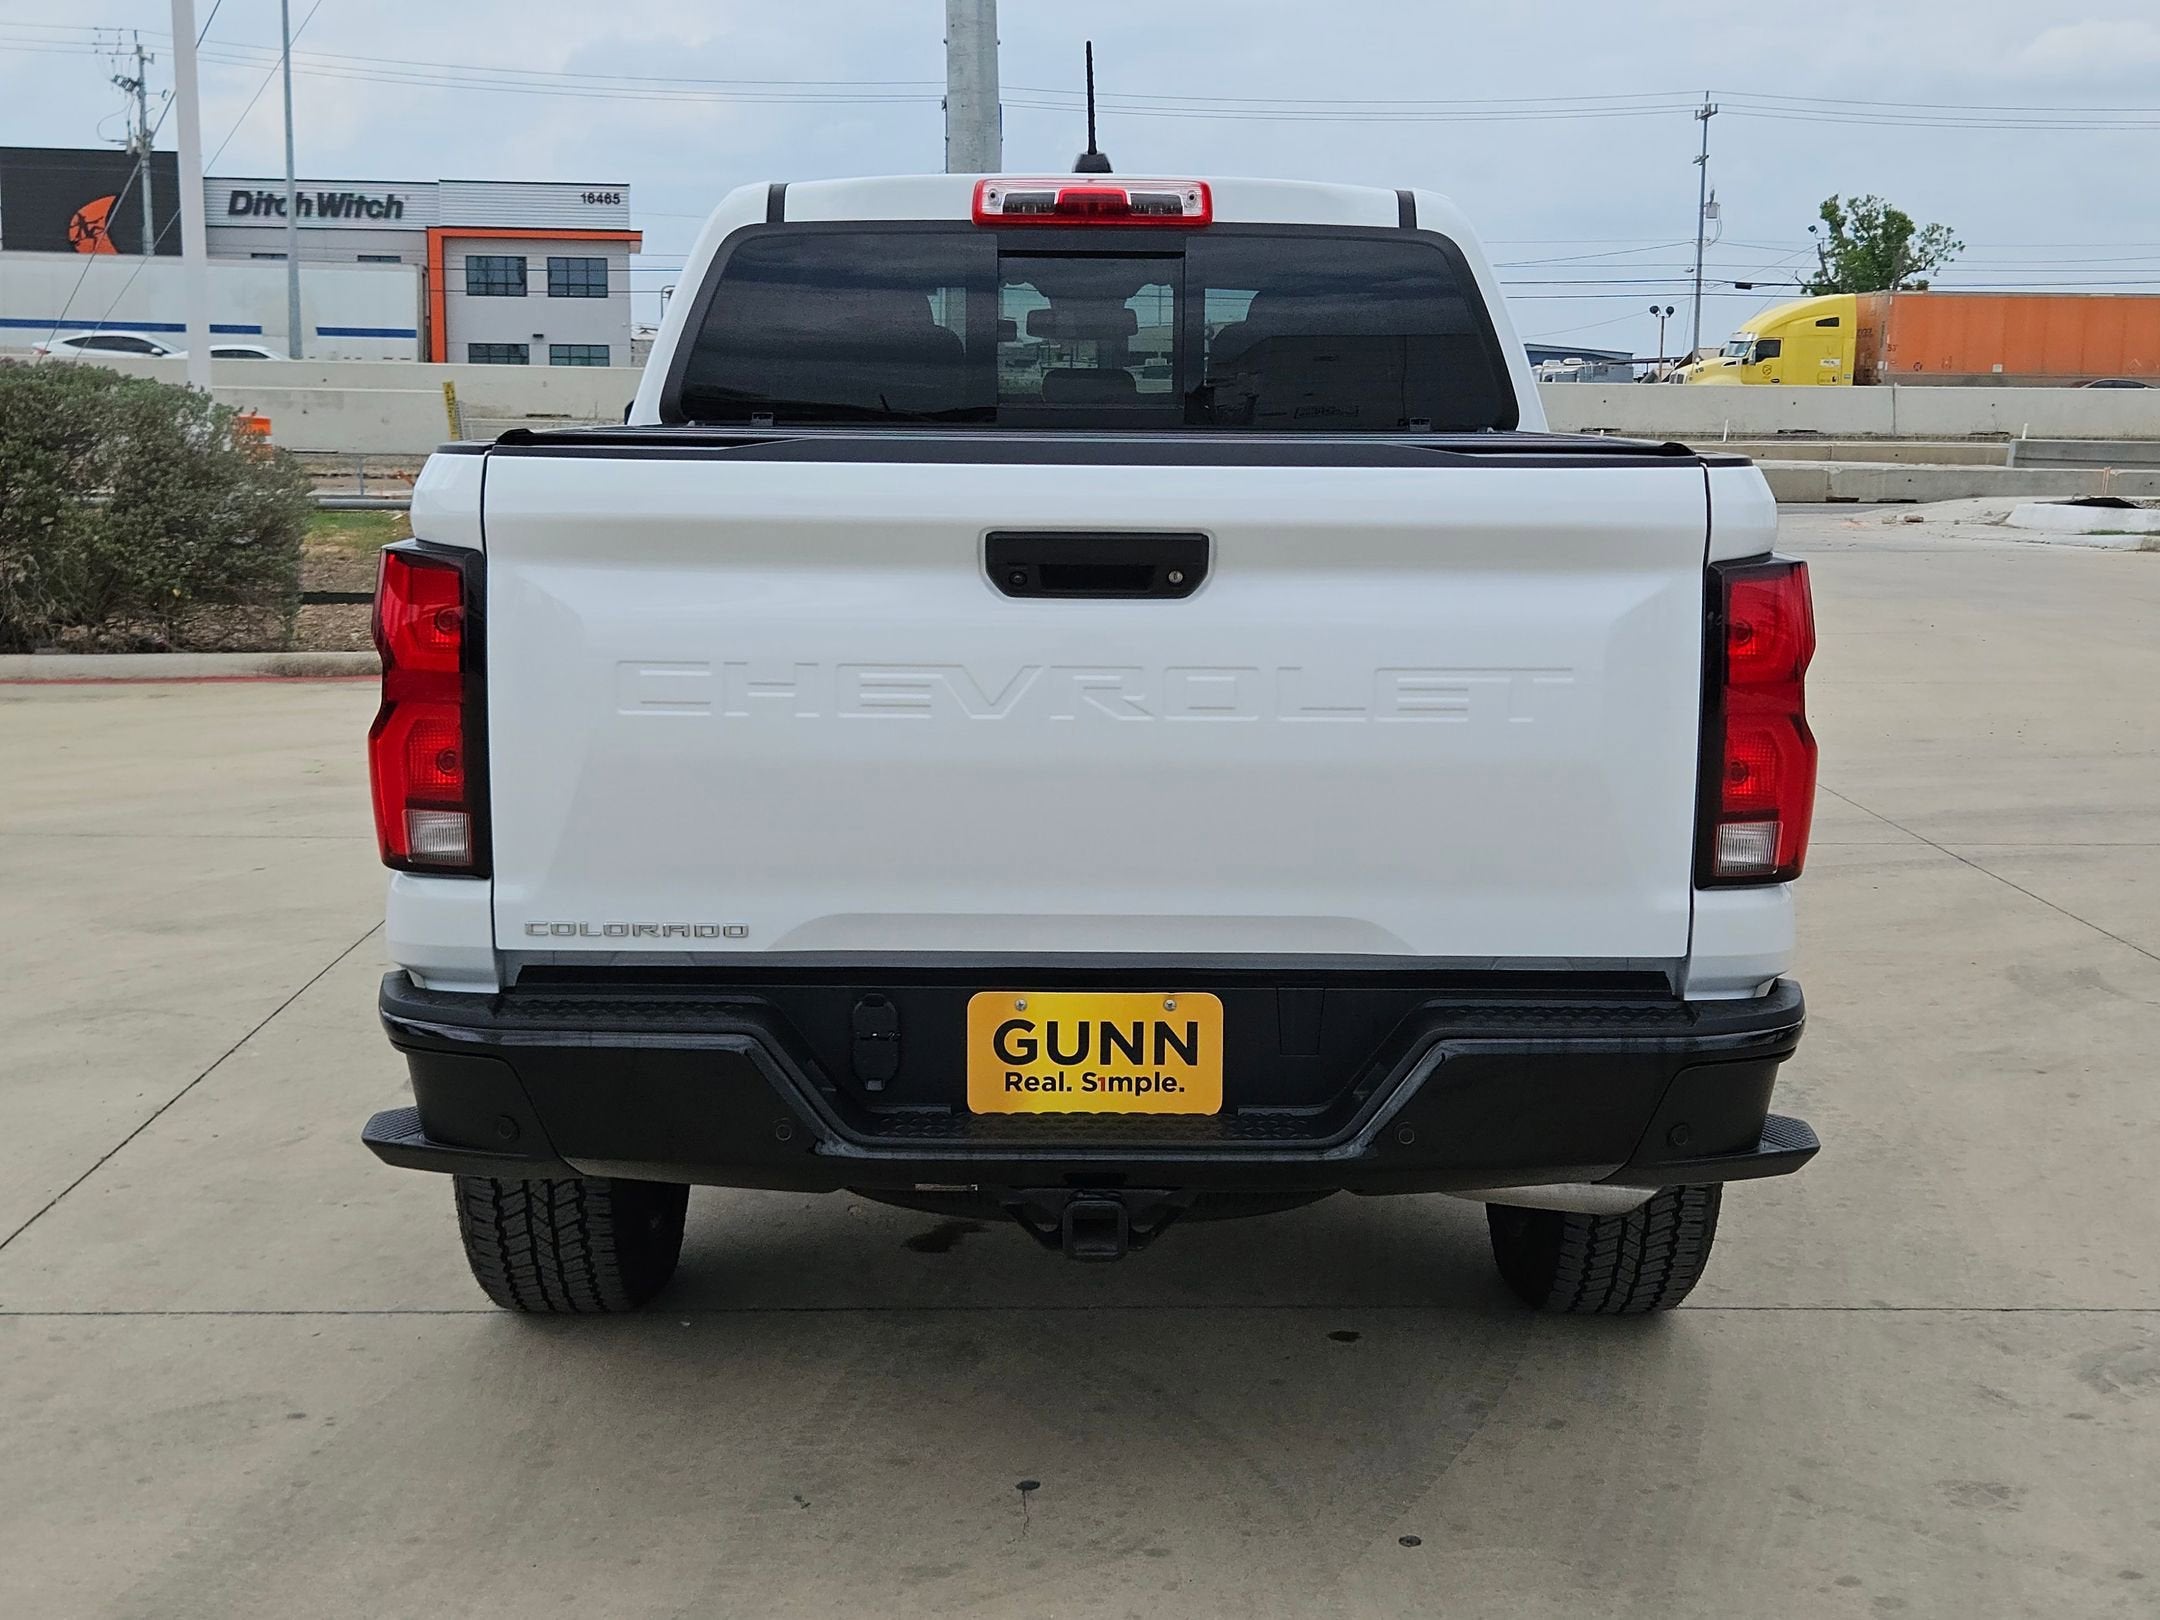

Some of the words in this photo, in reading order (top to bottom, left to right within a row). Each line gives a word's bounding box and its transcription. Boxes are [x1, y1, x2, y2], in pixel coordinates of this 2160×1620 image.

[228, 190, 312, 217] Ditch
[316, 192, 405, 219] Witch
[580, 192, 621, 205] 16465
[615, 660, 1575, 722] CHEVROLET
[524, 920, 750, 939] COLORADO
[992, 1018, 1199, 1066] GUNN
[1004, 1071, 1073, 1093] Real.
